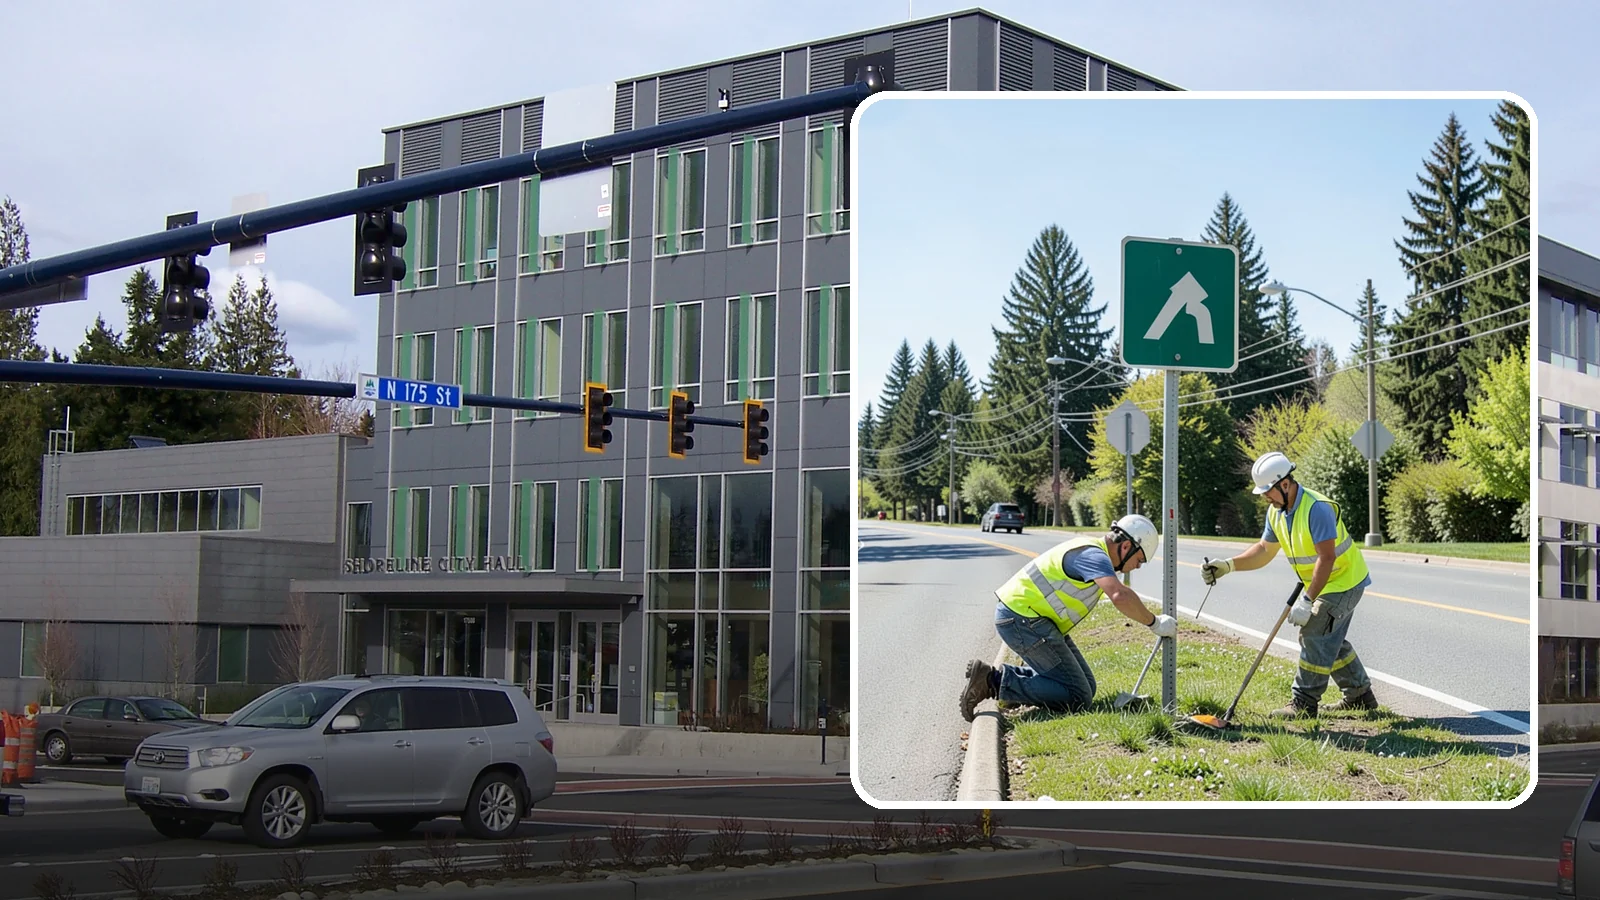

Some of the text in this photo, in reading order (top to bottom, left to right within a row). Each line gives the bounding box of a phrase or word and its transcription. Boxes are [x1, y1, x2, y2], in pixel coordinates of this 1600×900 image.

[387, 380, 451, 406] N 175 St
[343, 555, 526, 574] SHORELINE CITY HALL
